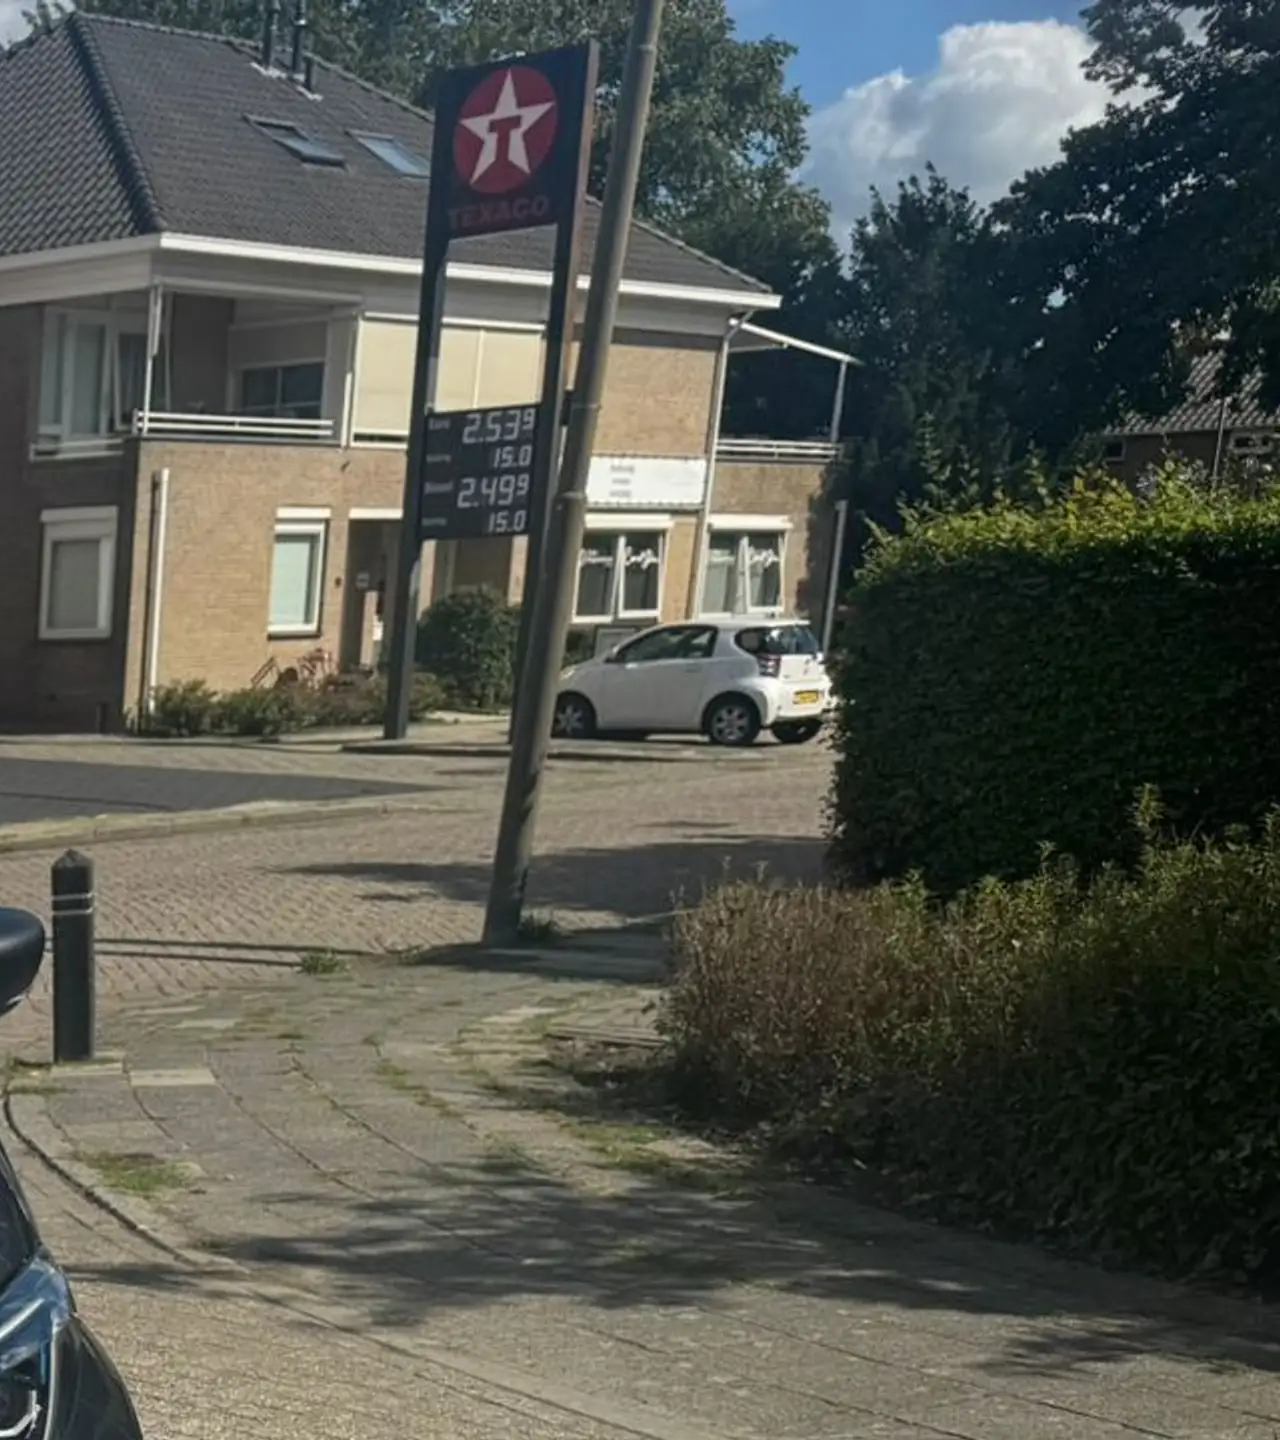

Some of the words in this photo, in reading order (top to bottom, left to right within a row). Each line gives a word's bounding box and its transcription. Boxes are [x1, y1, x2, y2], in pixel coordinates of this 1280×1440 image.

[446, 195, 550, 231] TEXACO
[462, 408, 536, 443] 2.539
[493, 444, 533, 468] 15.0
[457, 473, 530, 508] 2.499
[488, 509, 527, 533] 15.0
